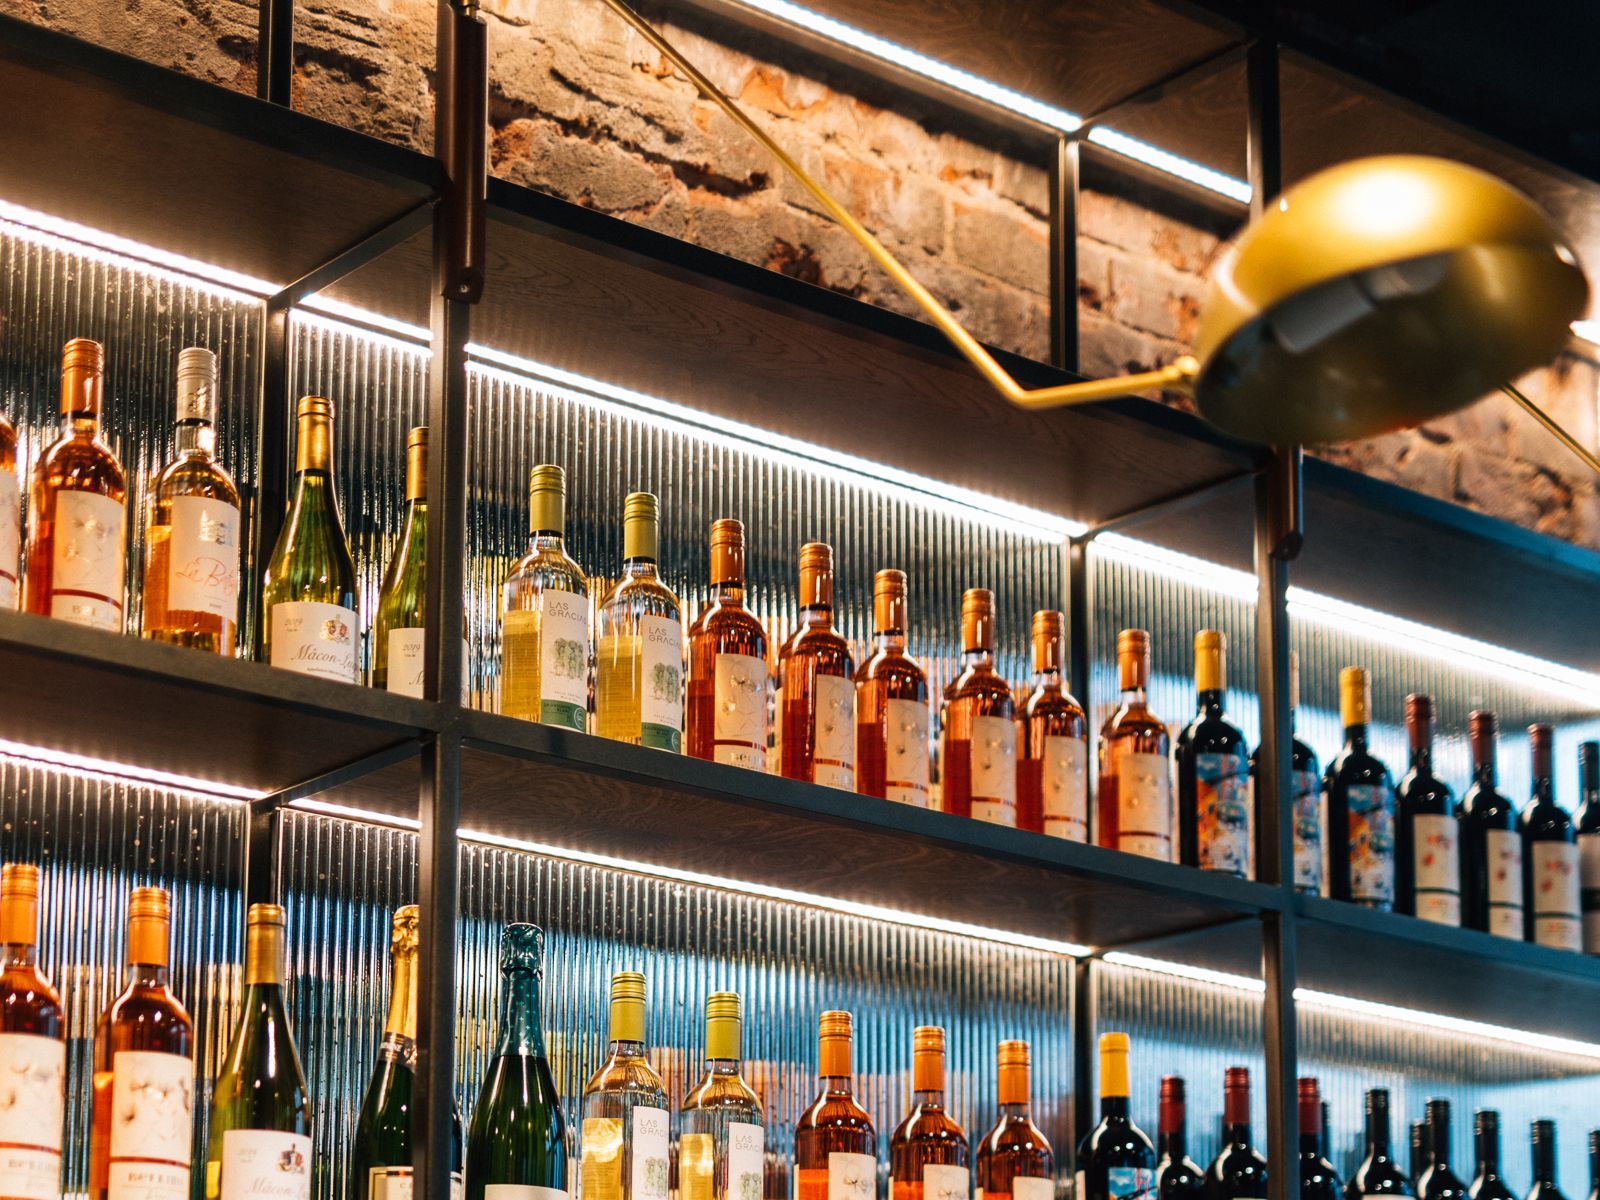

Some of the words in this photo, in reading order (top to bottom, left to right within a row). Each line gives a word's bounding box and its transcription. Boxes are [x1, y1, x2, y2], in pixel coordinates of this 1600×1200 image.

[549, 601, 569, 611] LAS
[648, 627, 668, 637] LAS
[640, 1119, 658, 1128] LAS
[736, 1135, 753, 1144] LAS
